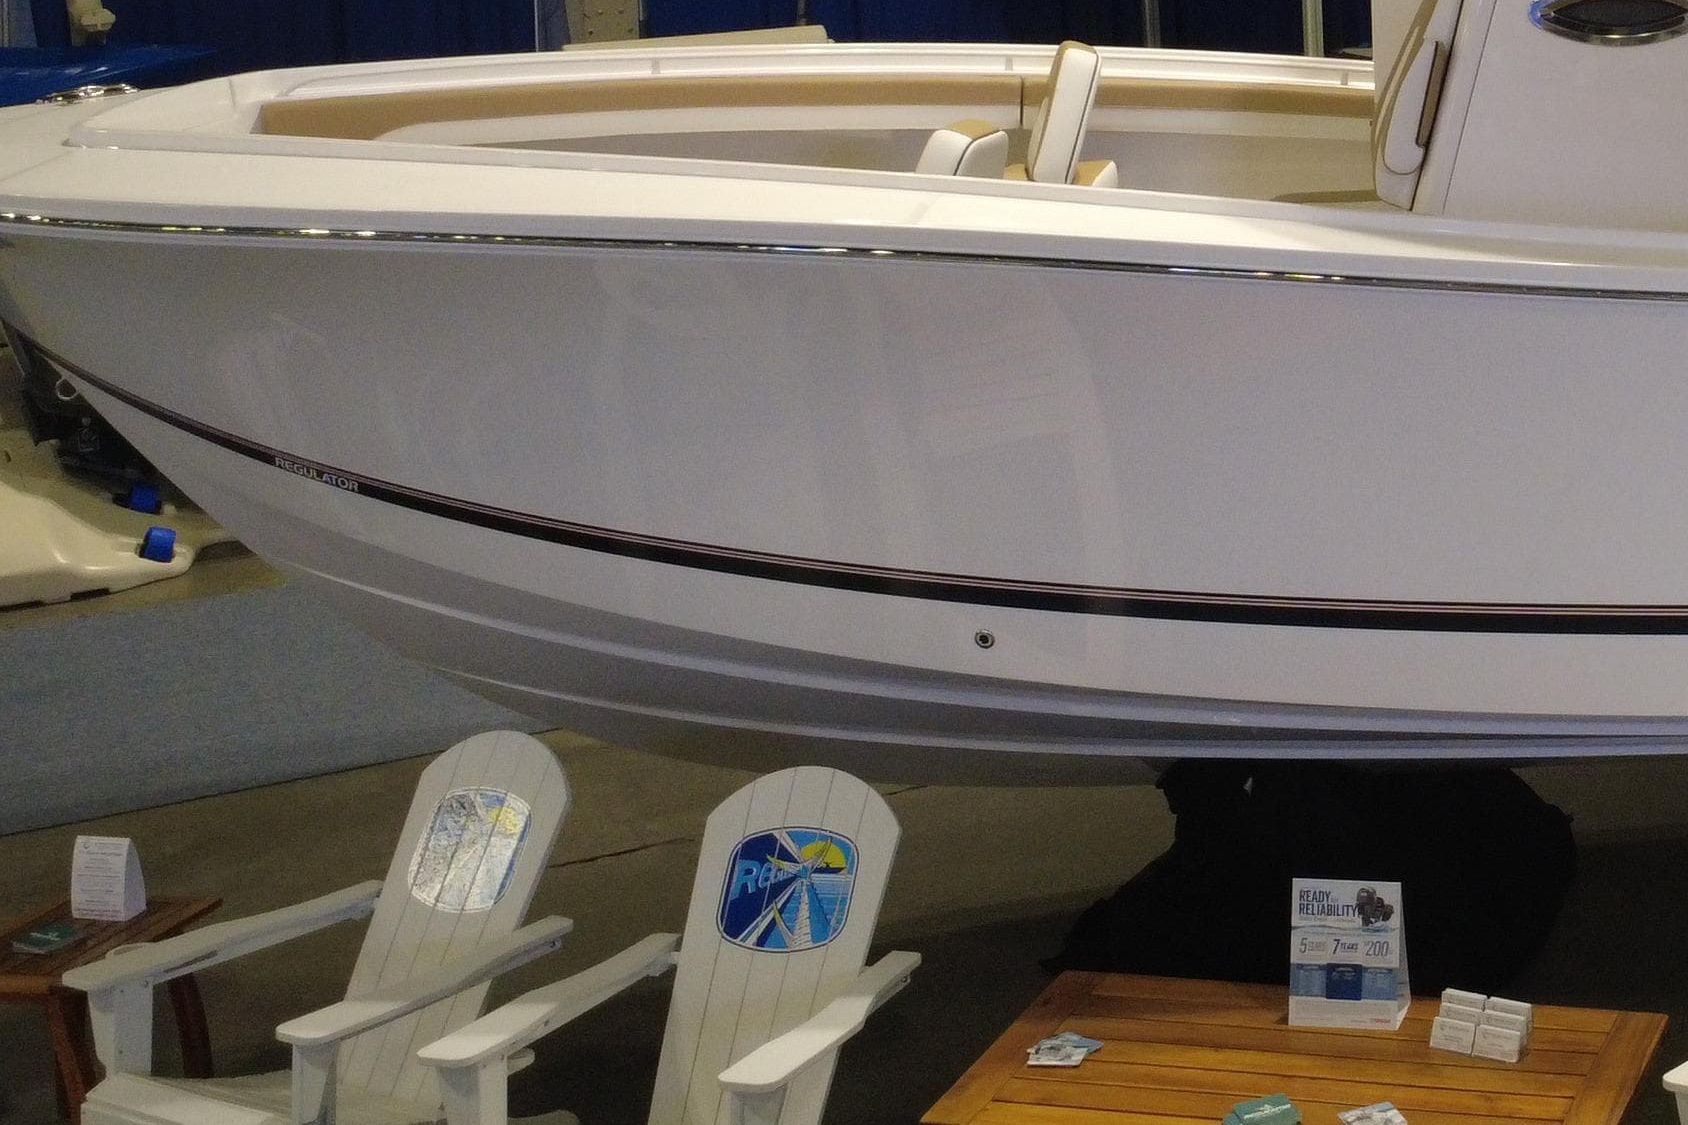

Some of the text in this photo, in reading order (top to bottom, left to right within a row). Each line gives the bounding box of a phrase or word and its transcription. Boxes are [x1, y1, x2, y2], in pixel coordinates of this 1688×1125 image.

[274, 457, 360, 492] REGULATOR
[1299, 889, 1332, 903] READY
[1299, 902, 1357, 917] RELIABILITY
[1332, 938, 1341, 955] 7
